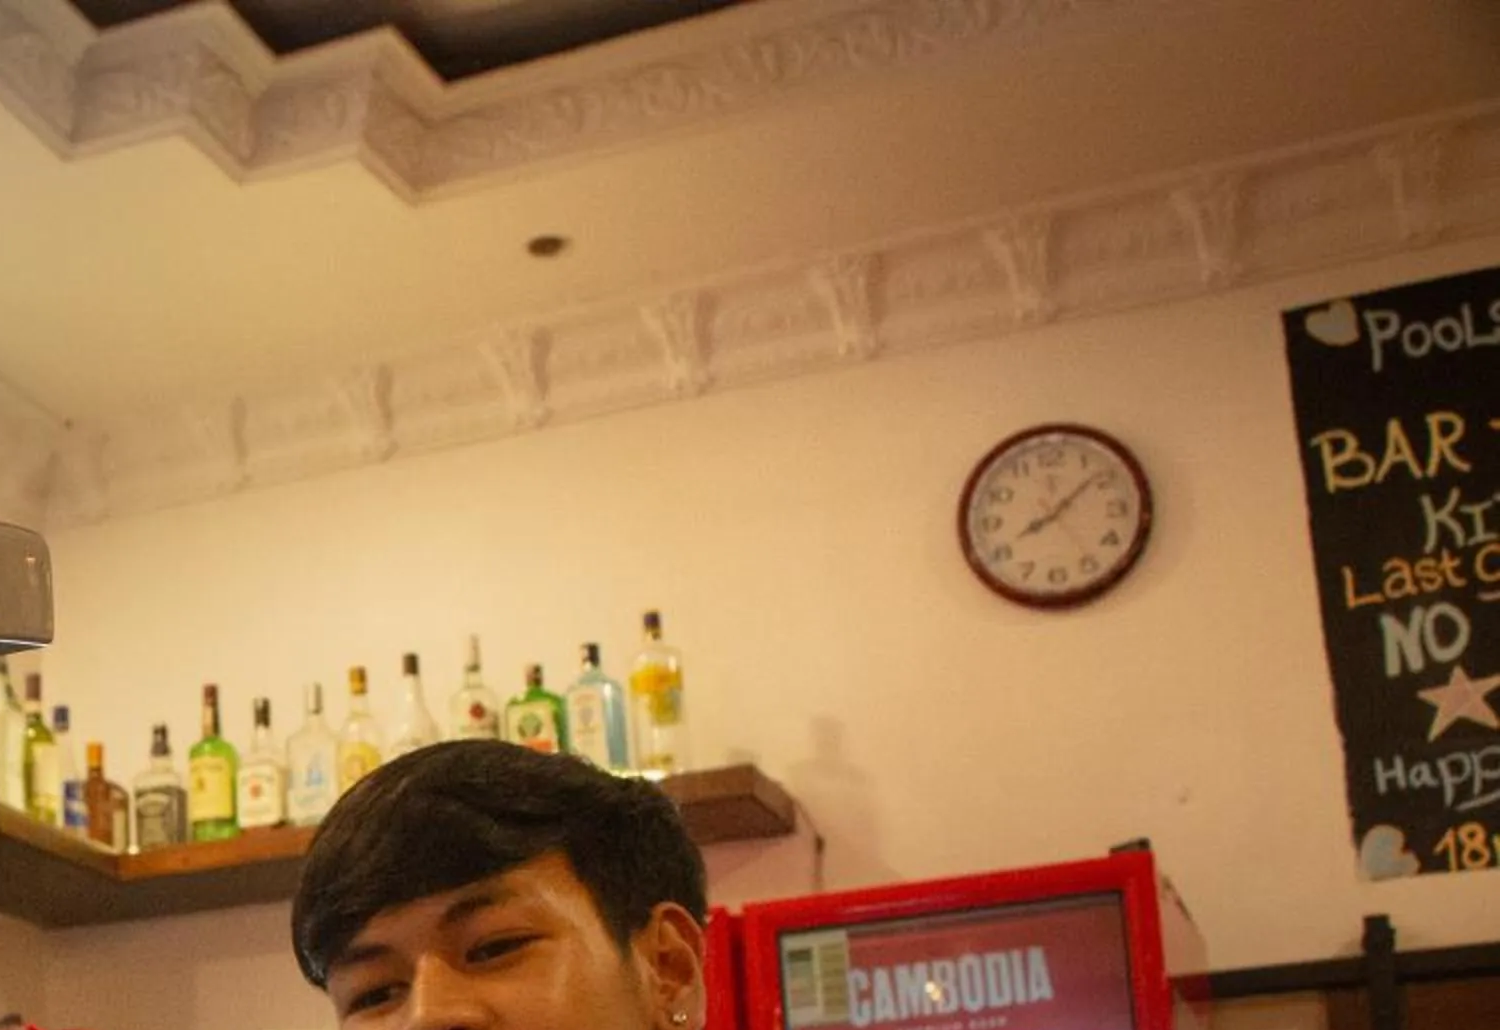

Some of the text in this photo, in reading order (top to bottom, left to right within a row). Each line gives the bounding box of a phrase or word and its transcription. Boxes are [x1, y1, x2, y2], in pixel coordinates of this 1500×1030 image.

[1309, 411, 1472, 493] BAR
[1420, 486, 1500, 554] KI
[1342, 547, 1467, 609] Last
[1379, 601, 1471, 677] NO
[849, 945, 1055, 1029] CAMBODIA
